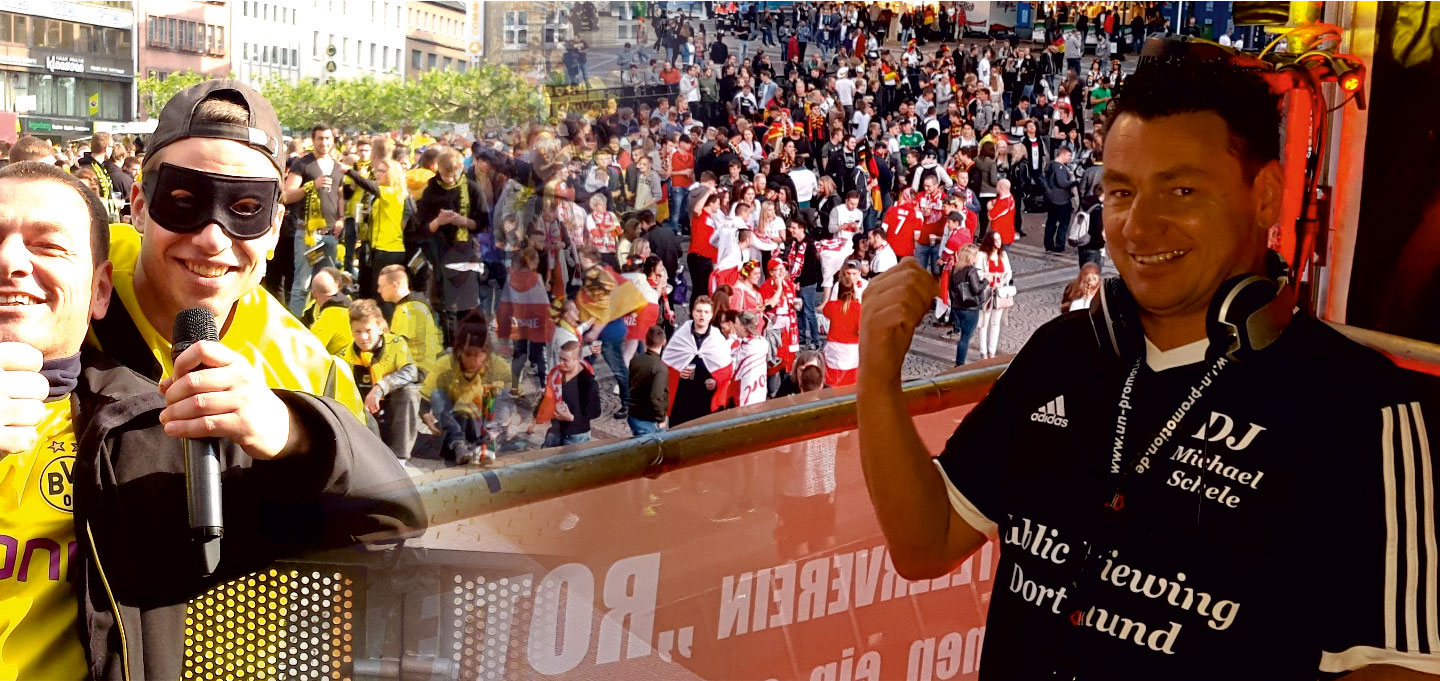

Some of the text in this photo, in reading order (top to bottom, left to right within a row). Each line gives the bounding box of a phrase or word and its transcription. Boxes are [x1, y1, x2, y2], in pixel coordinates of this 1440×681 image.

[894, 215, 906, 235] 7
[1030, 411, 1069, 428] adidas
[1191, 411, 1268, 451] DJ
[1169, 445, 1265, 490] Michael
